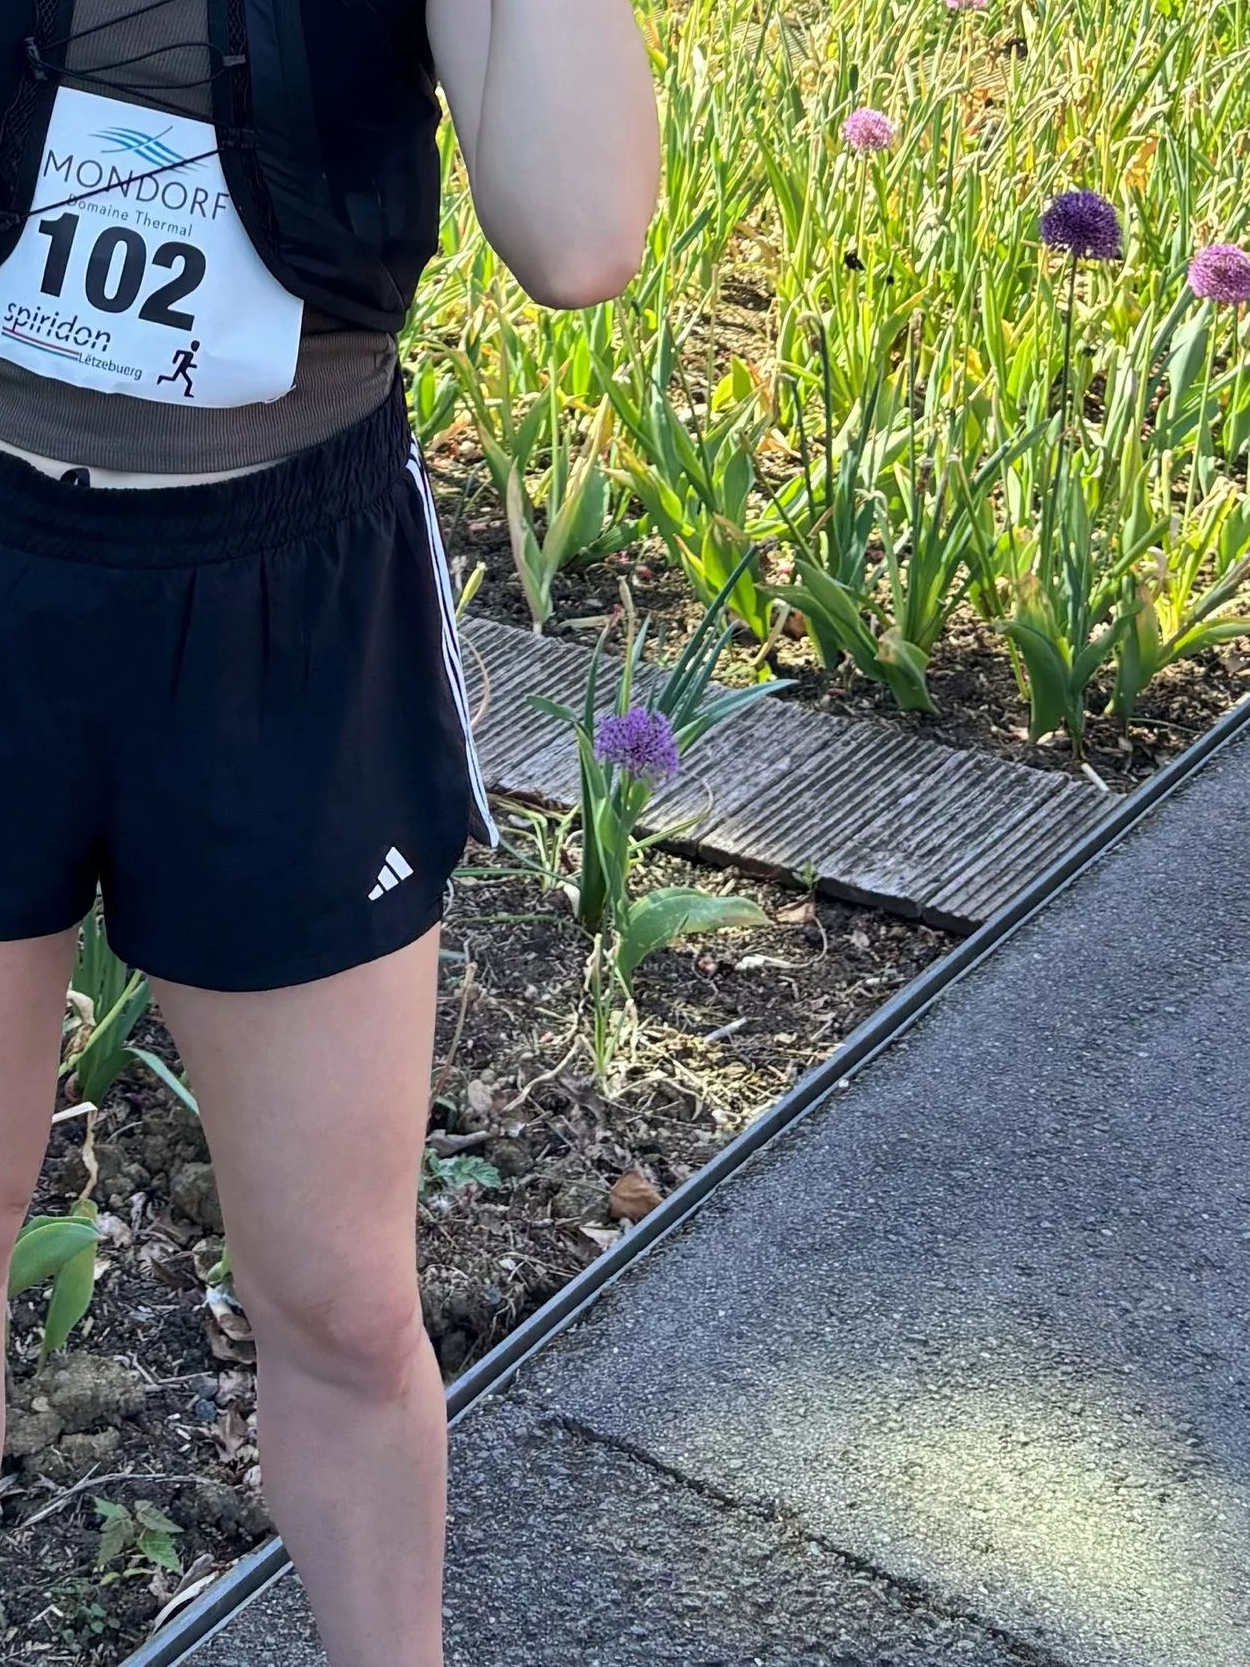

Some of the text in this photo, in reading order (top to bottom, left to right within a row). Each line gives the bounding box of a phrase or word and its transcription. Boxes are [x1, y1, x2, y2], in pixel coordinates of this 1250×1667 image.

[43, 149, 230, 220] MONDORF
[66, 194, 193, 237] Domaine Thermal
[38, 211, 207, 332] 102
[3, 302, 111, 352] spiridon
[77, 352, 143, 381] Lëtzebuerg
